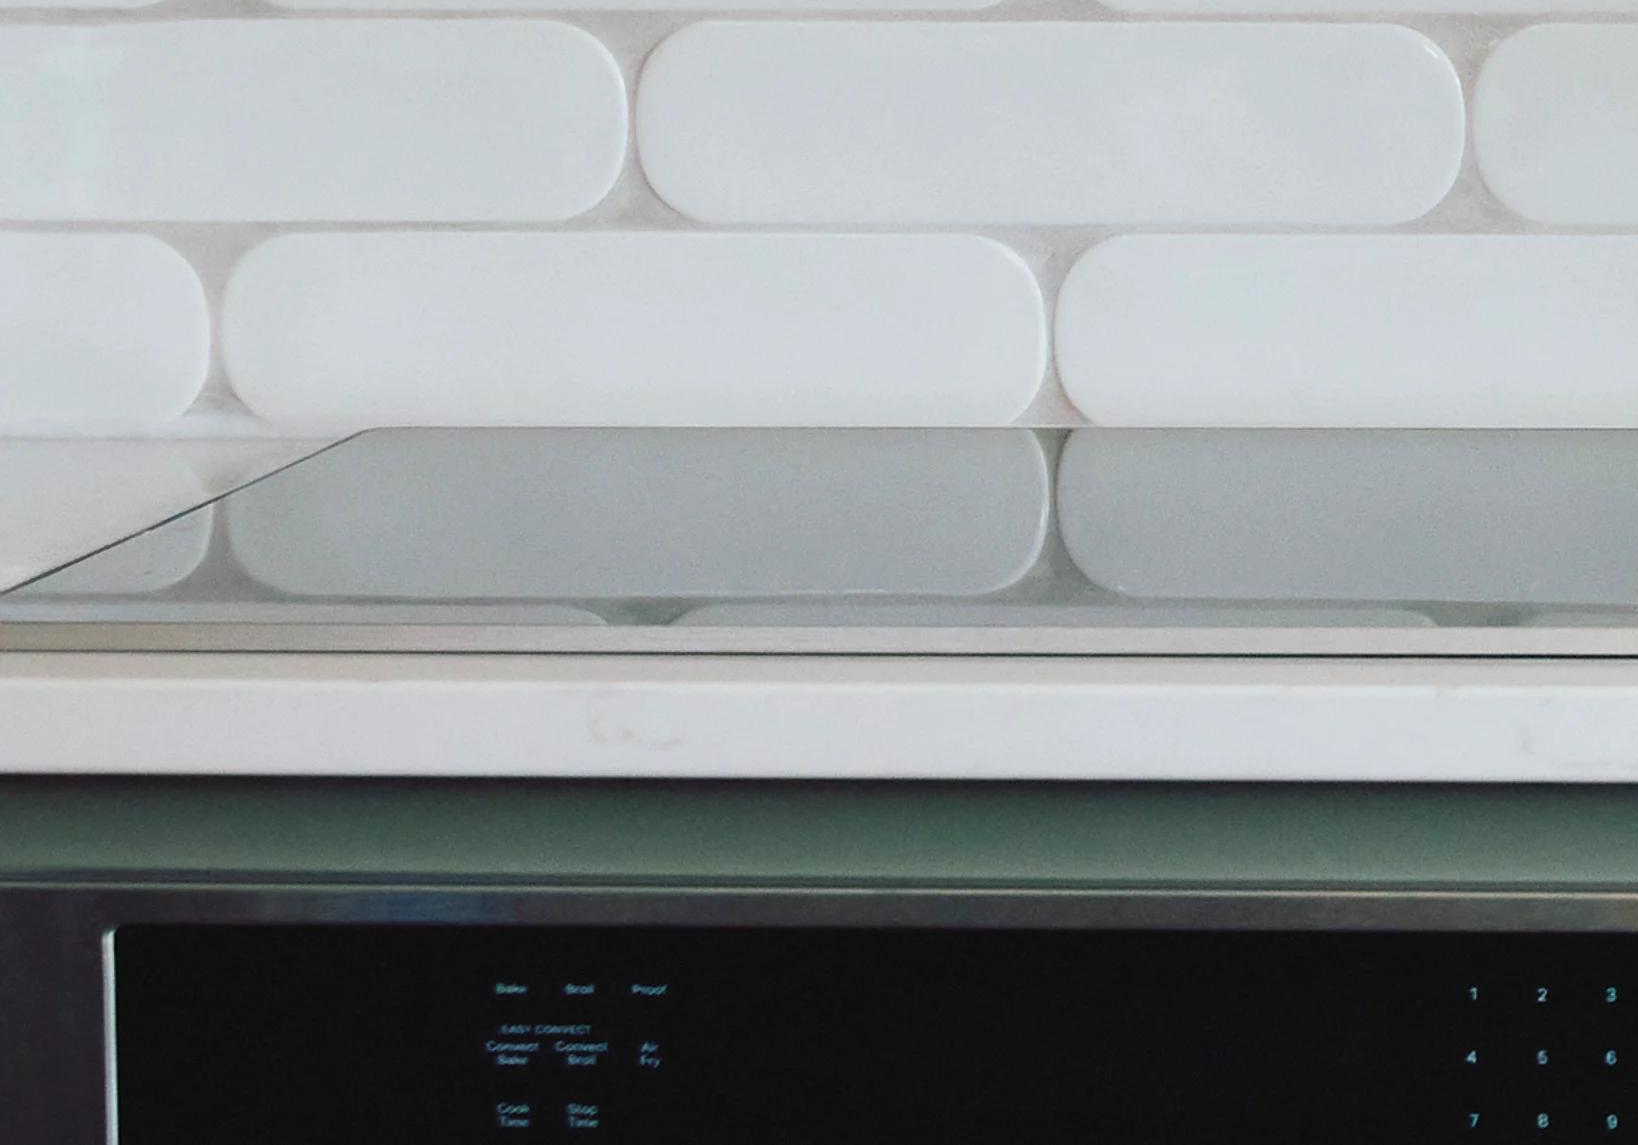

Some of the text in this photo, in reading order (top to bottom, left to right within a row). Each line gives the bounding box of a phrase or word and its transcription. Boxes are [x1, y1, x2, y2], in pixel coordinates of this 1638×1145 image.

[1469, 987, 1478, 1001] 1
[1537, 988, 1547, 1002] 2
[1606, 987, 1616, 1002] 3
[640, 1055, 661, 1068] Fry
[1465, 1051, 1477, 1063] 4
[1537, 1050, 1548, 1065] 5
[1605, 1050, 1617, 1065] 6
[1469, 1113, 1479, 1127] 7
[1537, 1113, 1549, 1128] 8
[1606, 1114, 1618, 1129] 9
